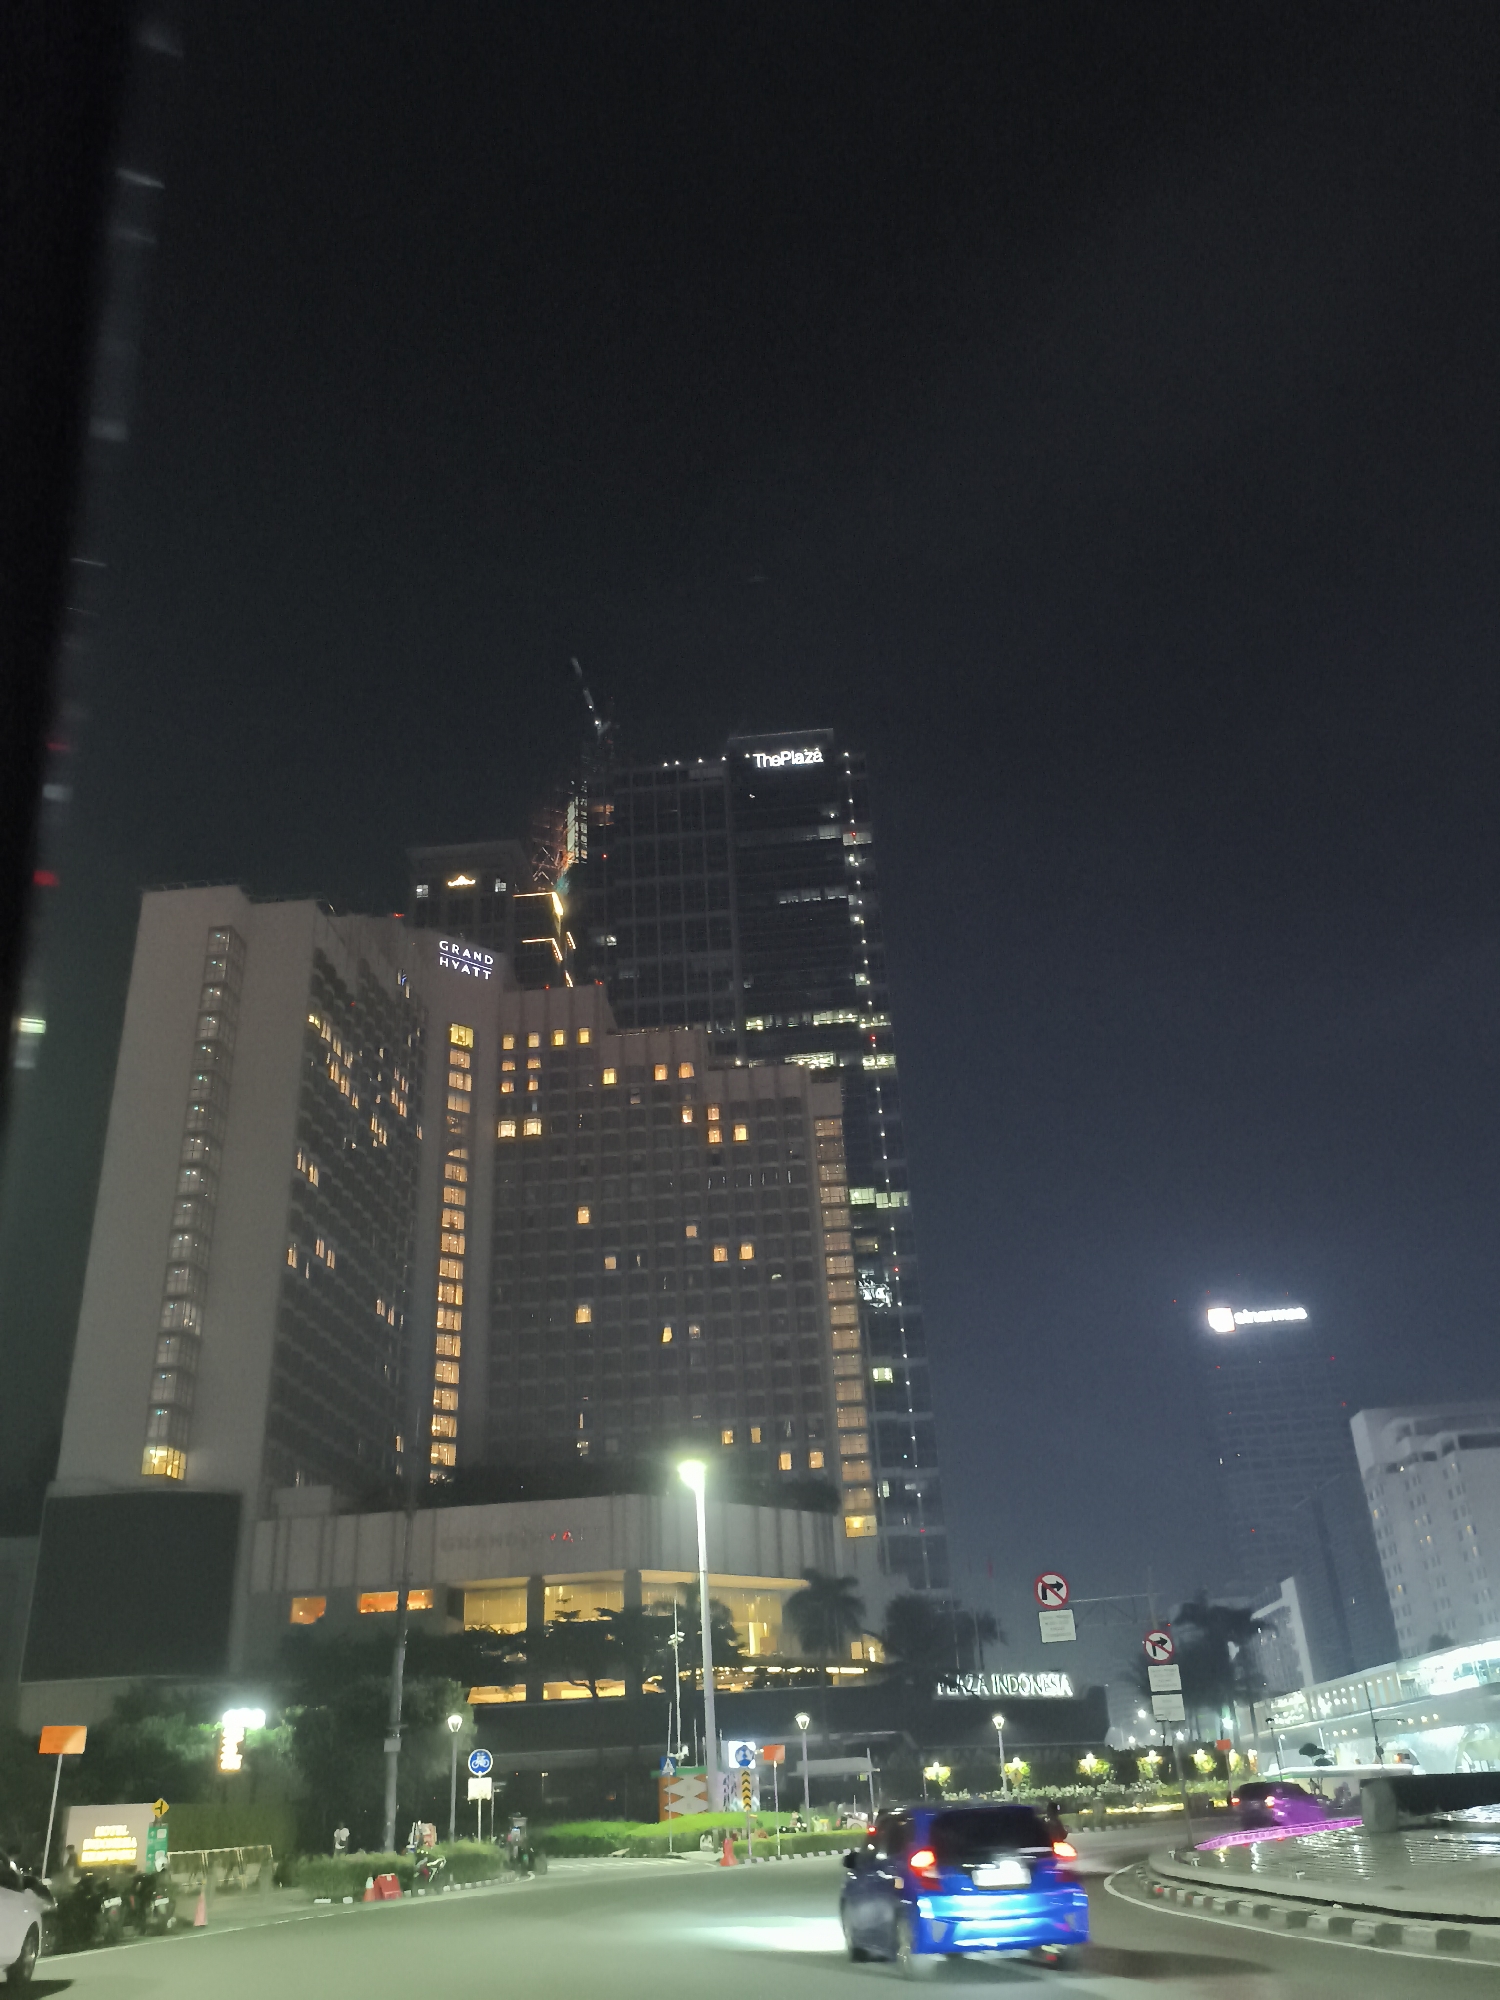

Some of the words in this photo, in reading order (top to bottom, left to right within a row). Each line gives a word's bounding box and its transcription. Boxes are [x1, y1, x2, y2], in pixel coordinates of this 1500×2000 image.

[439, 940, 494, 965] GRAND
[439, 956, 492, 980] HYATT
[991, 1673, 1073, 1696] INDONESIA
